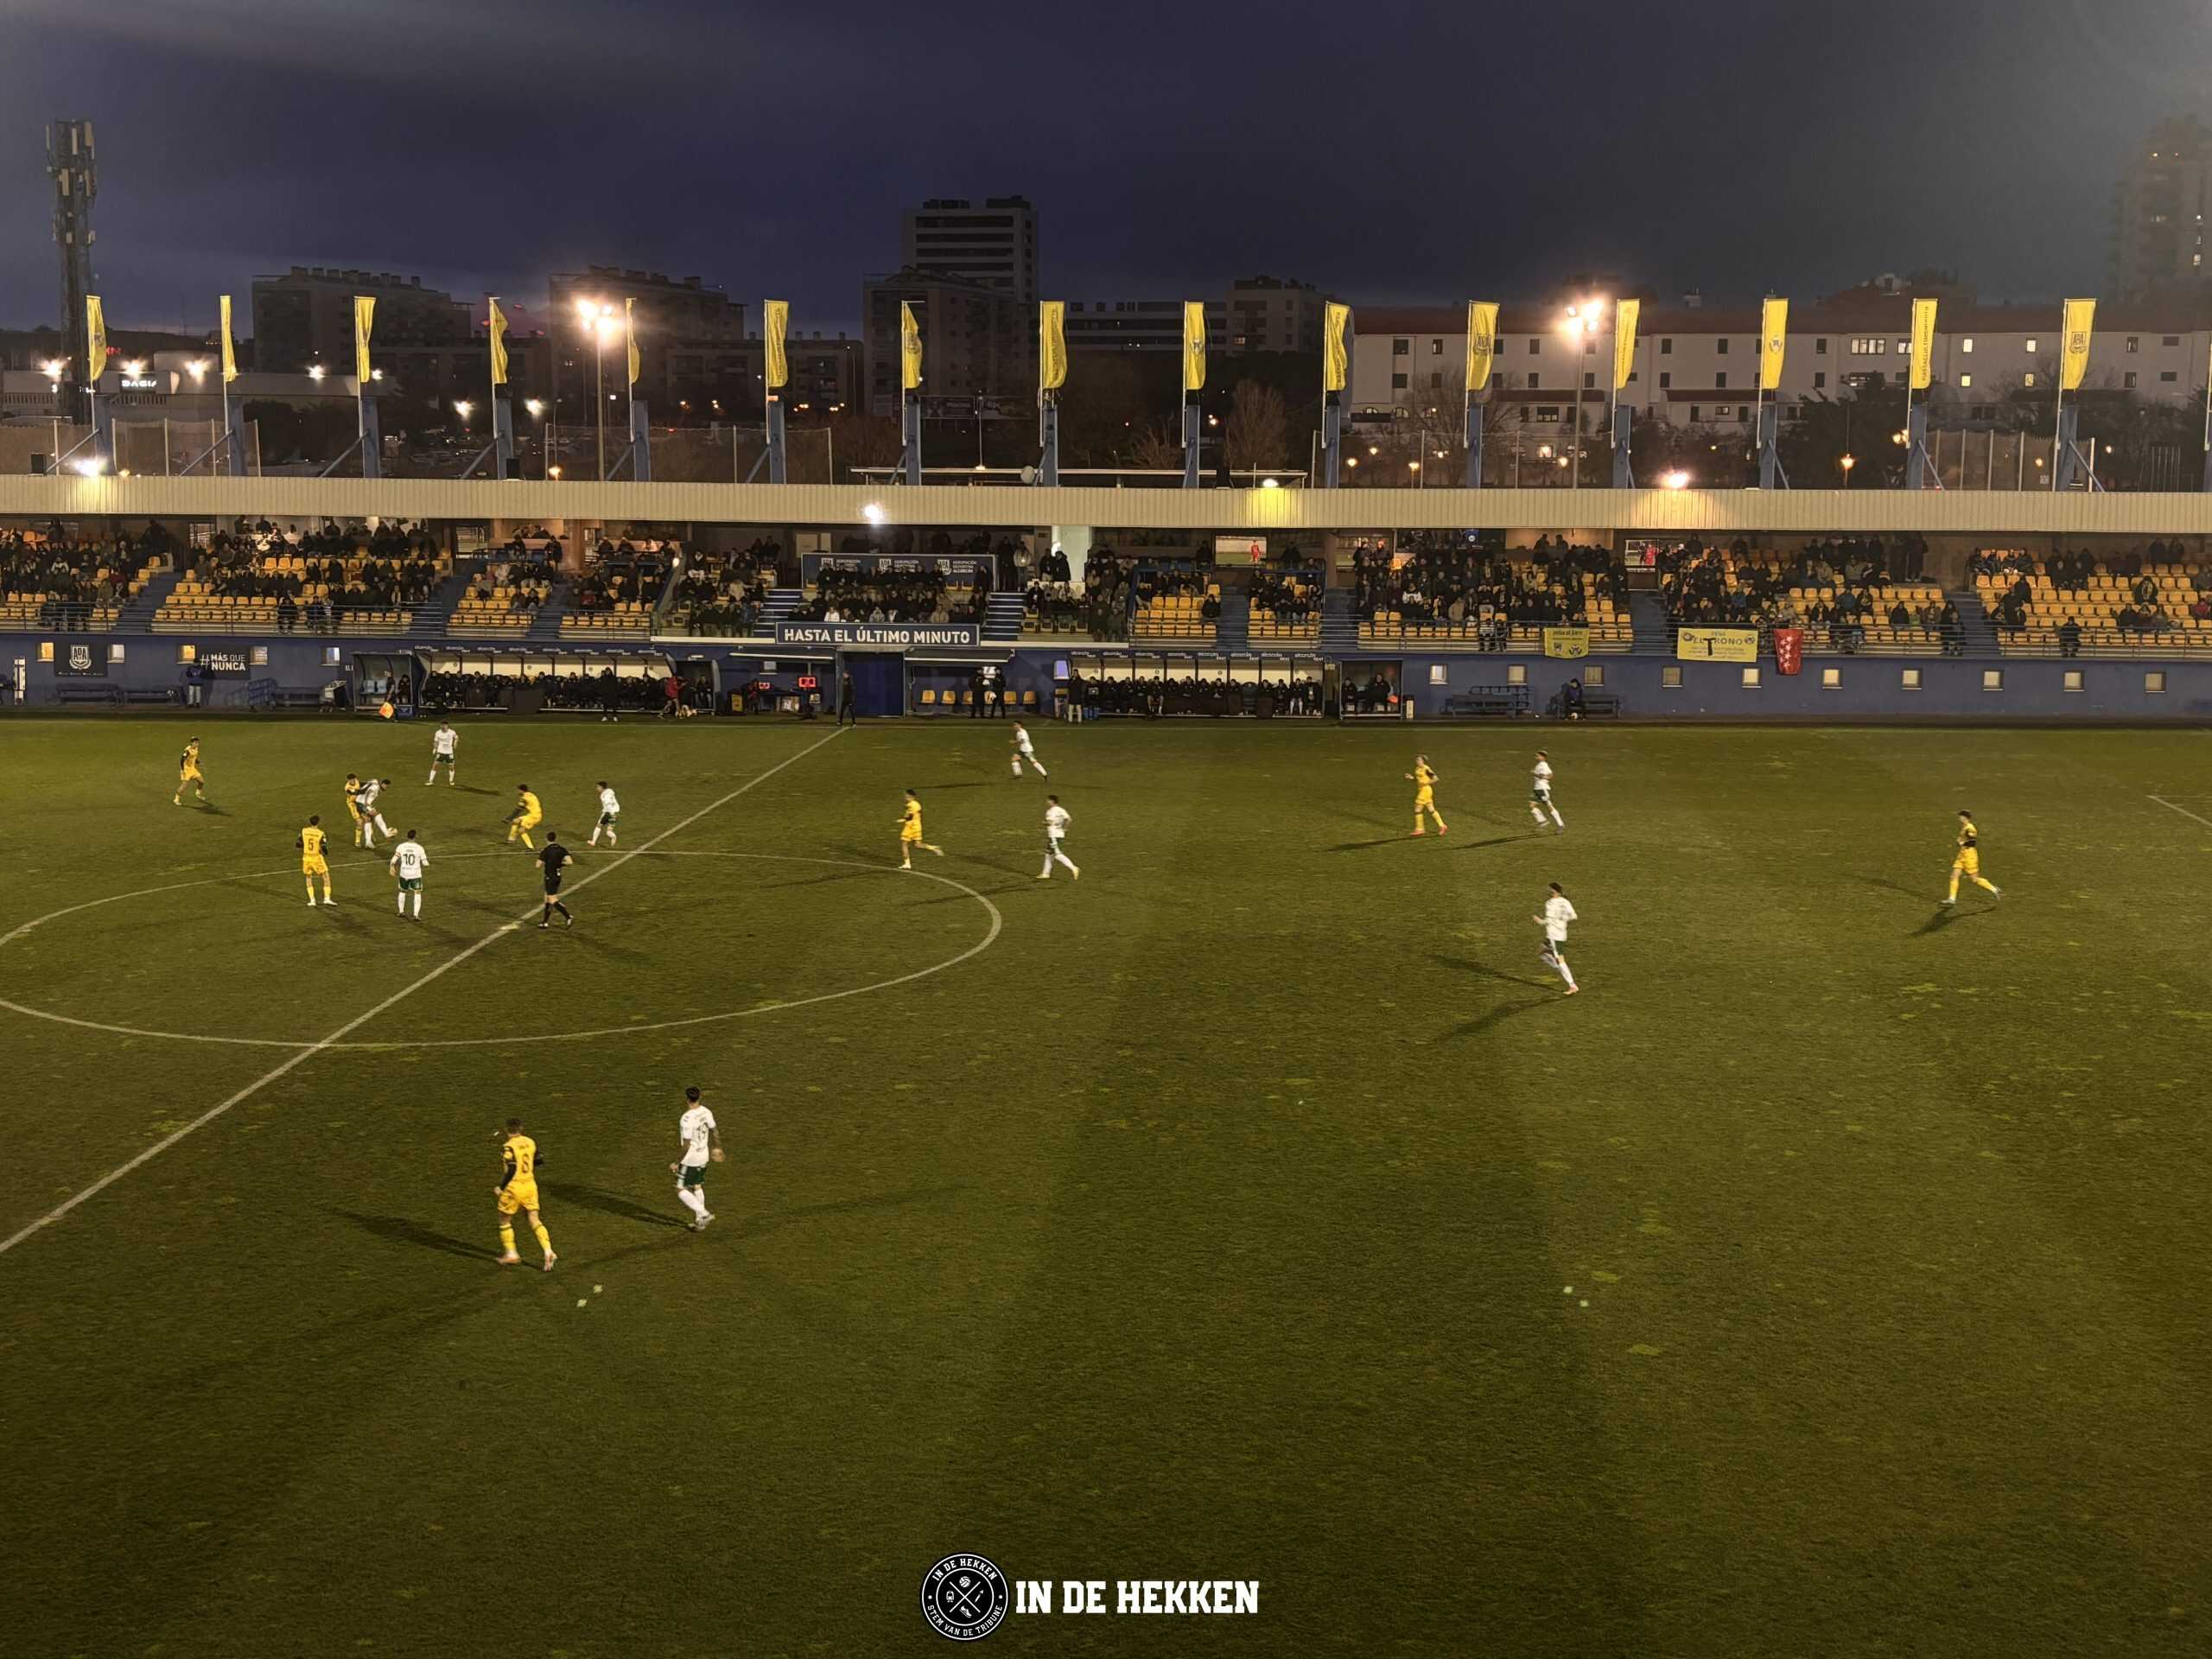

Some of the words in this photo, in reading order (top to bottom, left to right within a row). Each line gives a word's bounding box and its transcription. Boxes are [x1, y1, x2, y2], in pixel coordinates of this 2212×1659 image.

[785, 628, 830, 642] HASTA
[835, 630, 852, 642] EL
[856, 626, 909, 643] ÚLTIMO
[913, 631, 969, 644] MINUTO
[211, 662, 246, 671] NUNCA
[308, 838, 314, 850] 5
[403, 854, 415, 866] 10
